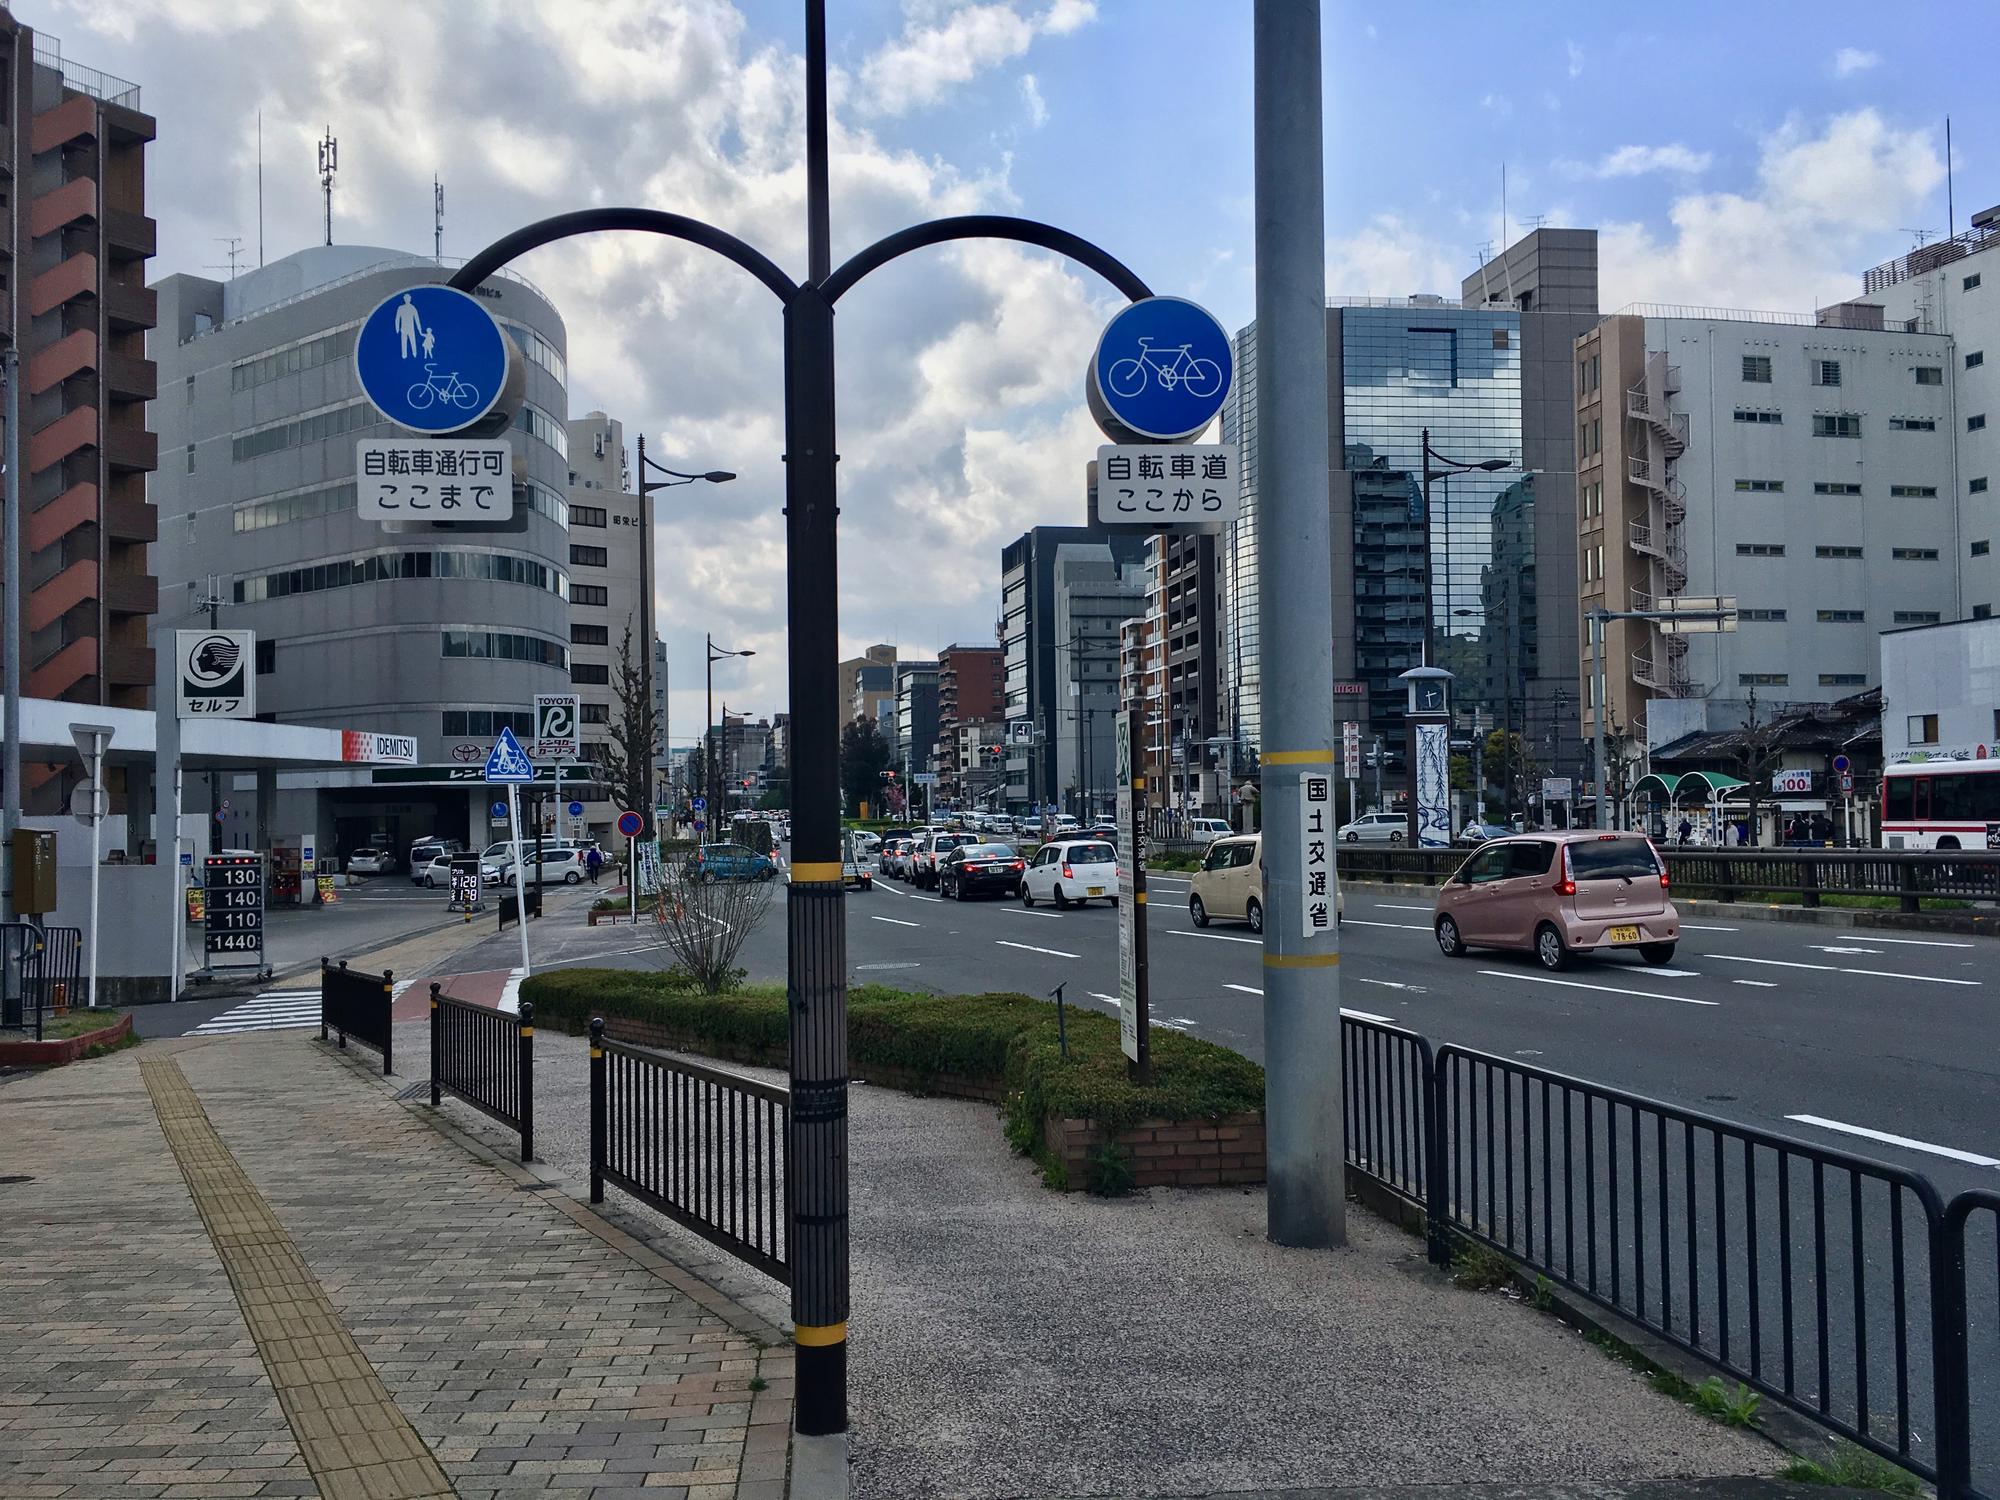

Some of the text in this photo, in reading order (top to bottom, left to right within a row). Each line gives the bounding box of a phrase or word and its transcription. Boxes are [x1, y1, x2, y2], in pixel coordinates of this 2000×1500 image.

[365, 449, 504, 476] 自転車通行可
[1107, 453, 1228, 480] 自転車道
[378, 484, 494, 509] ここまで
[1117, 487, 1222, 512] ここから
[613, 515, 648, 527] 昭栄ビ
[188, 699, 240, 713] セルフ
[538, 697, 575, 705] TOYOTA
[377, 736, 414, 757] IDEMITSU
[1307, 778, 1328, 928] 国土交通省
[224, 869, 256, 885] 130
[460, 875, 477, 888] 128
[225, 891, 256, 907] 140
[225, 912, 256, 928] 110
[214, 934, 256, 950] 1440
